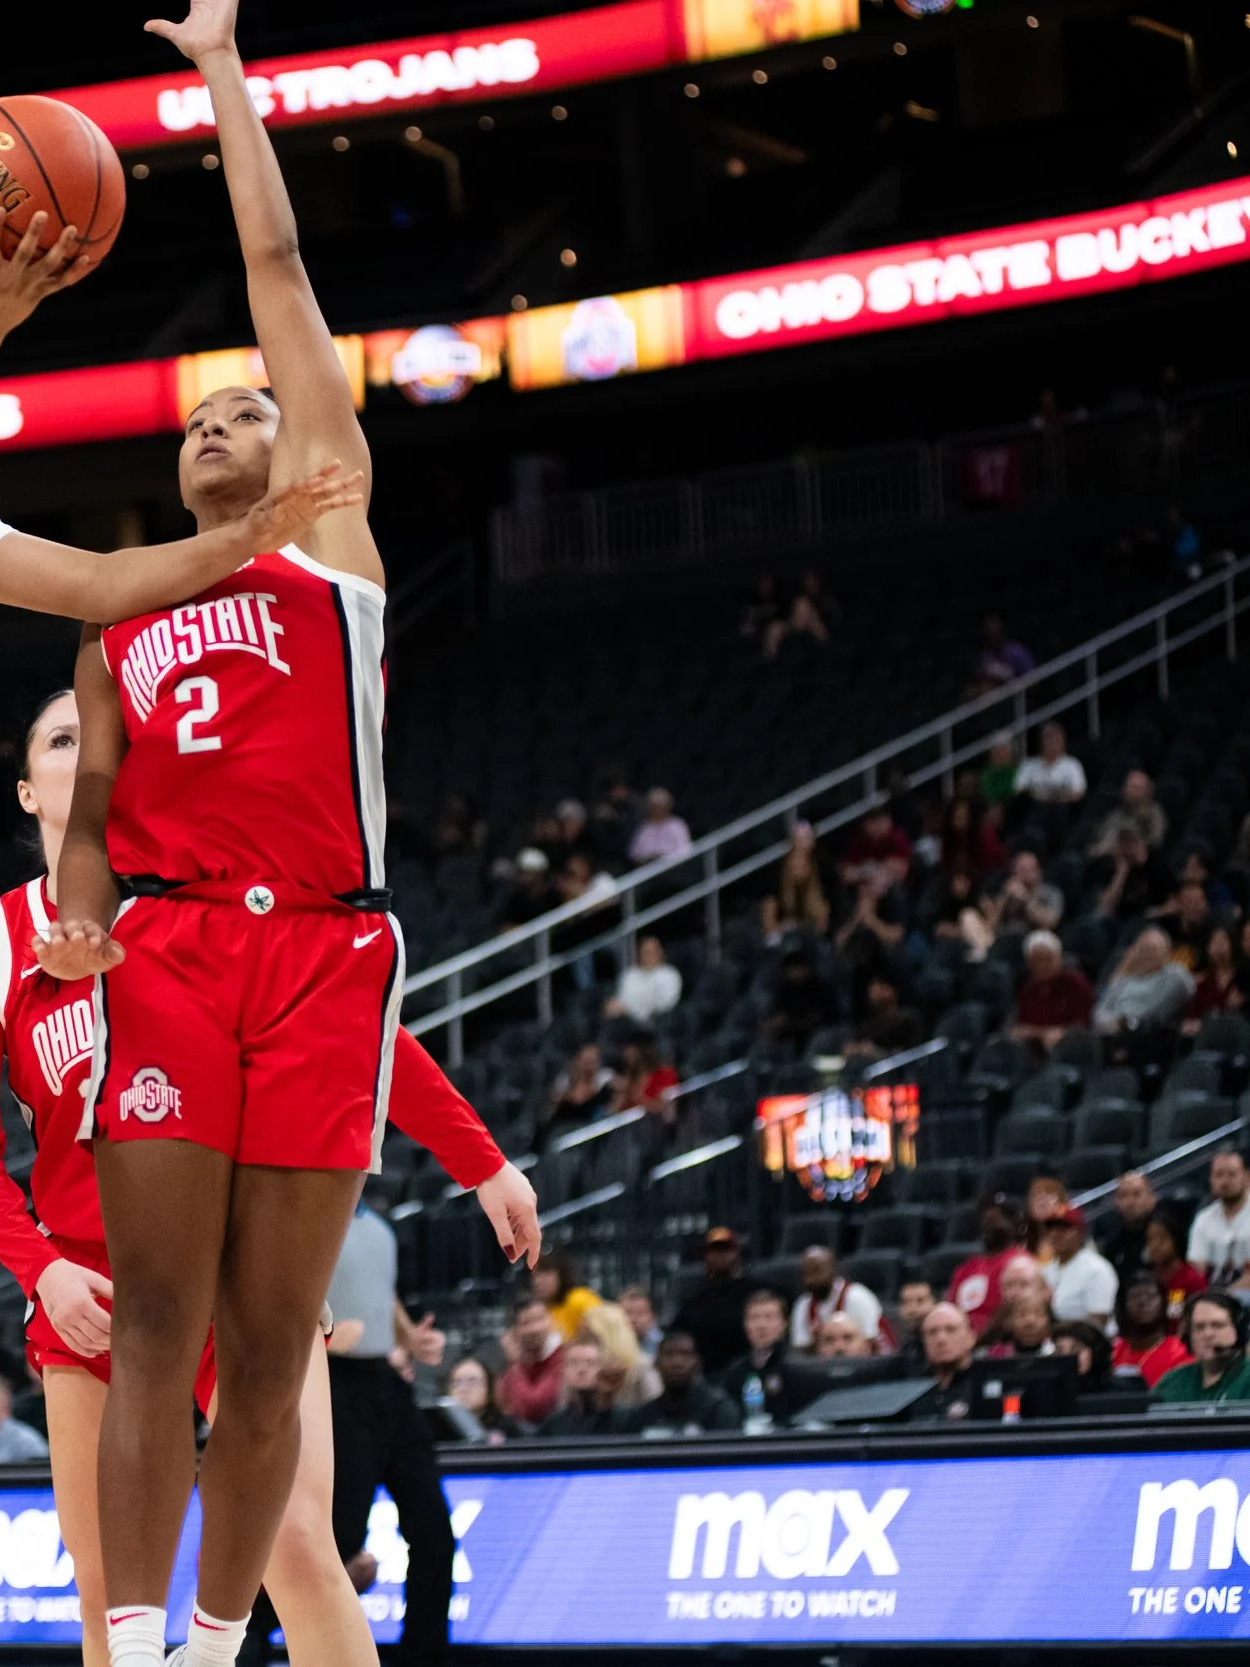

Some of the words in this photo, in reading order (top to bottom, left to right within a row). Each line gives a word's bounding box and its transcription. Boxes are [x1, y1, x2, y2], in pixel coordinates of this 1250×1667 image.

[272, 38, 541, 114] TROJANS
[716, 273, 864, 339] OHIO
[866, 240, 1052, 313] STATE
[174, 675, 223, 755] 2
[667, 1488, 911, 1580] max
[666, 1591, 713, 1620] THE
[712, 1591, 767, 1620] ONE
[769, 1590, 805, 1619] TO
[806, 1589, 898, 1619] WATCH
[1128, 1587, 1180, 1615] THE
[1184, 1586, 1243, 1615] ONE
